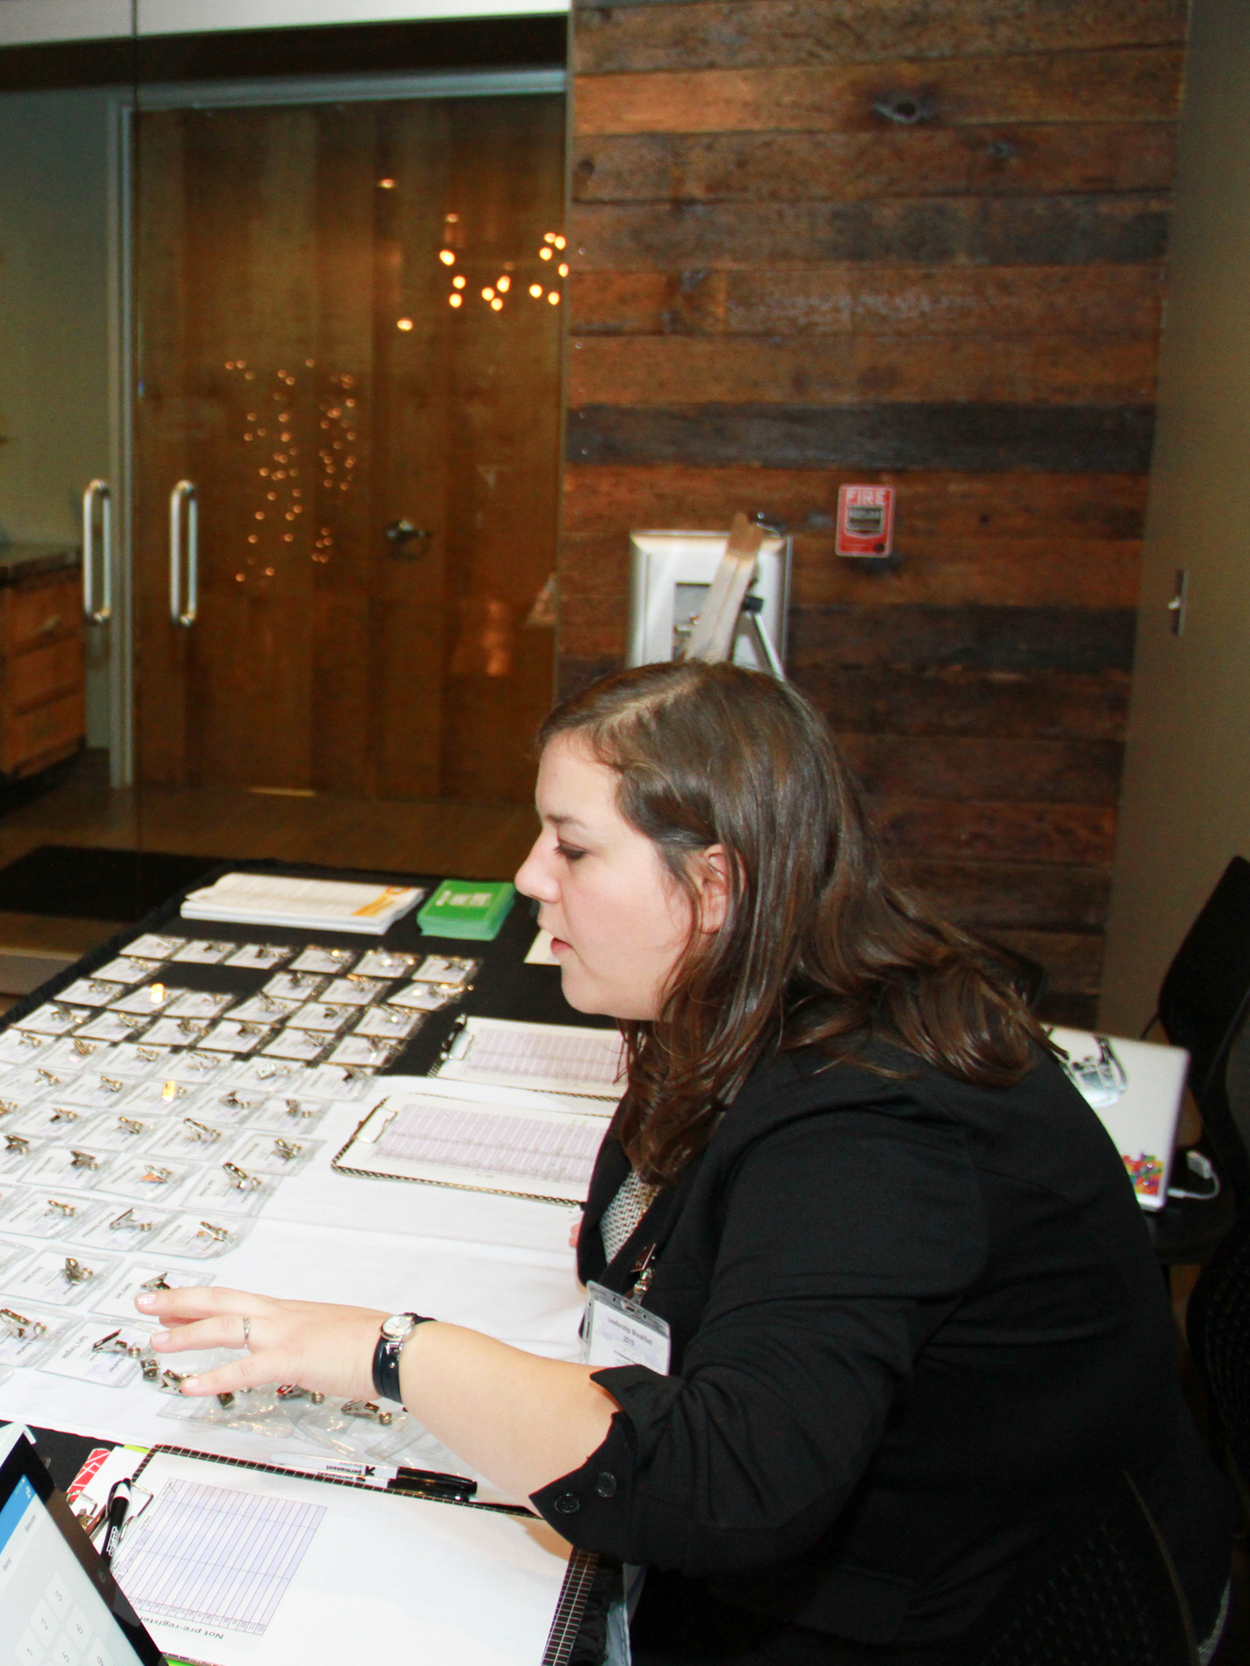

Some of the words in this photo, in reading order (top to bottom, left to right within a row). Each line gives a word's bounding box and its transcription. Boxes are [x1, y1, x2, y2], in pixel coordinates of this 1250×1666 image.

[845, 489, 886, 505] FIRE
[326, 1465, 362, 1475] permanent
[138, 1616, 198, 1638] pre-register
[201, 1630, 225, 1641] Not
